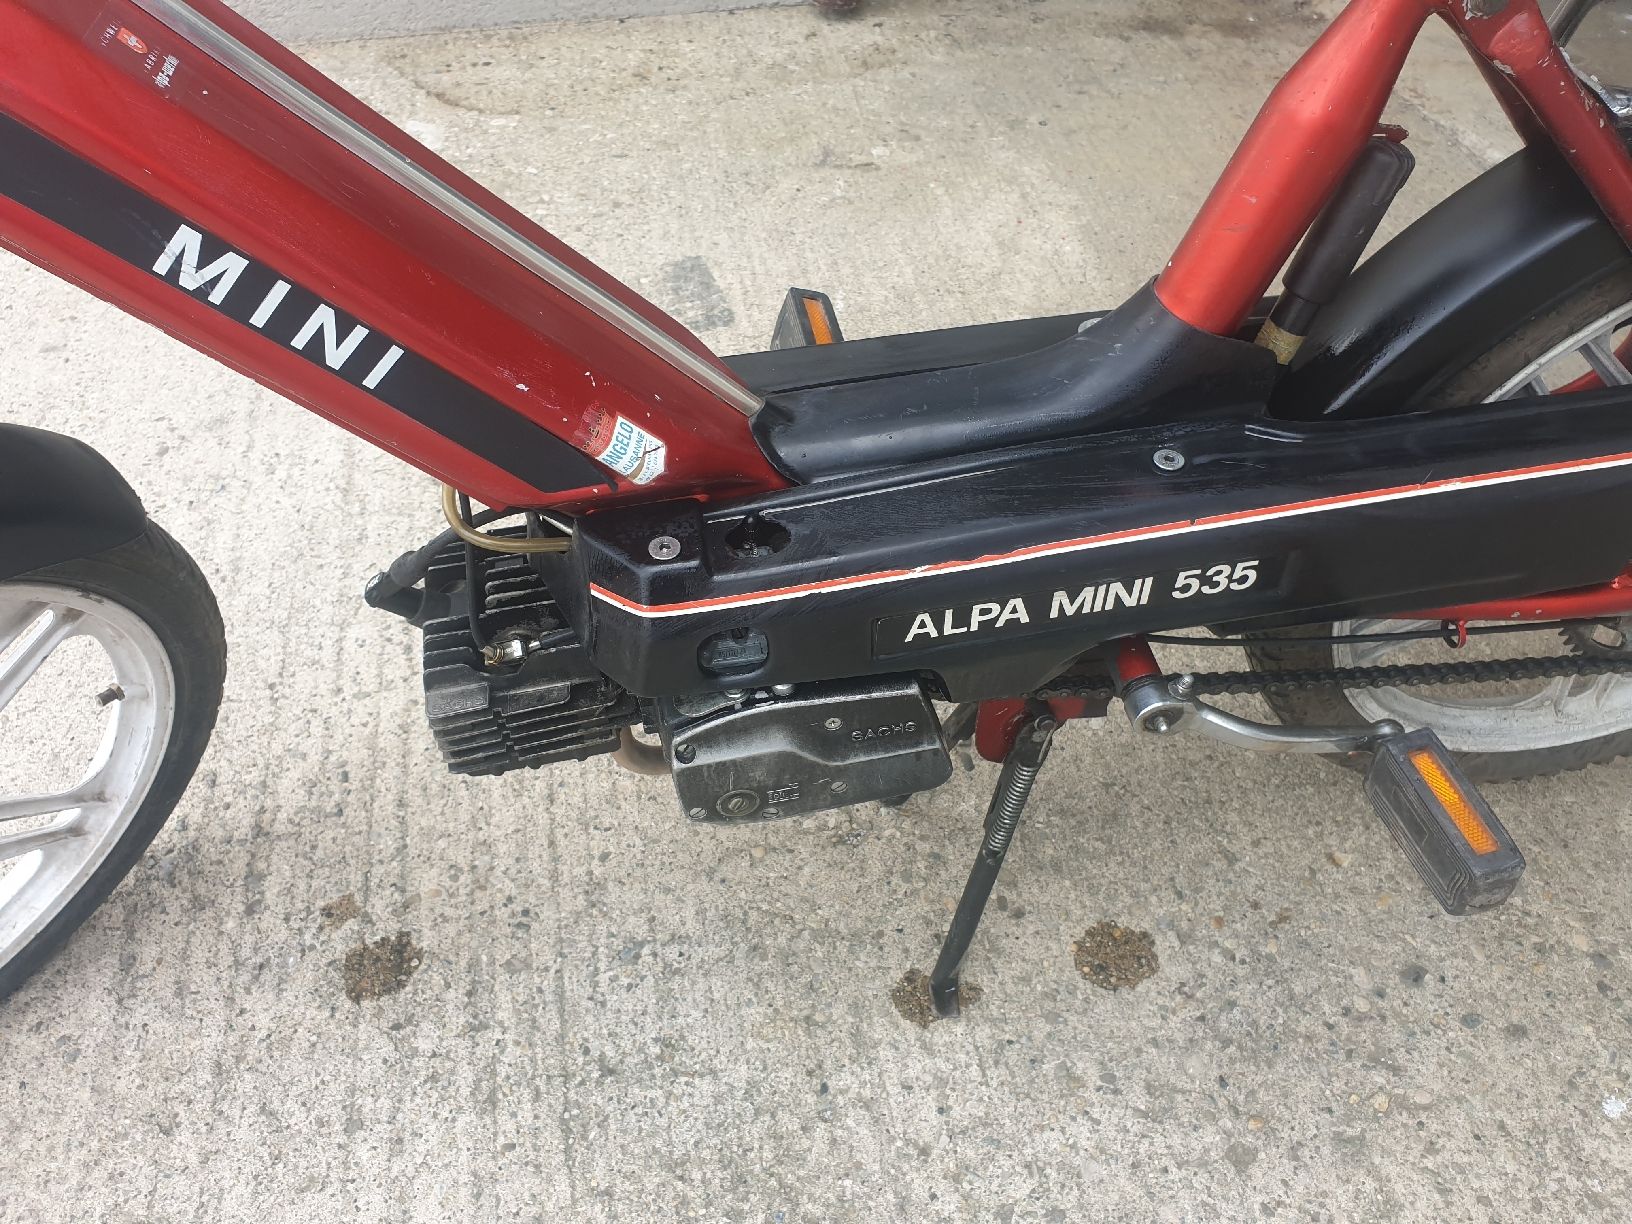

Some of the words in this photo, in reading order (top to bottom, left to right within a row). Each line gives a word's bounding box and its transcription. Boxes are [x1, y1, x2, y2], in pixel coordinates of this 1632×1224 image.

[152, 223, 405, 390] MINI
[601, 420, 634, 468] ANGELO
[904, 597, 1030, 643] ALPA
[1049, 576, 1154, 619] MINI
[1171, 559, 1260, 599] 535
[851, 720, 918, 742] SACHS
